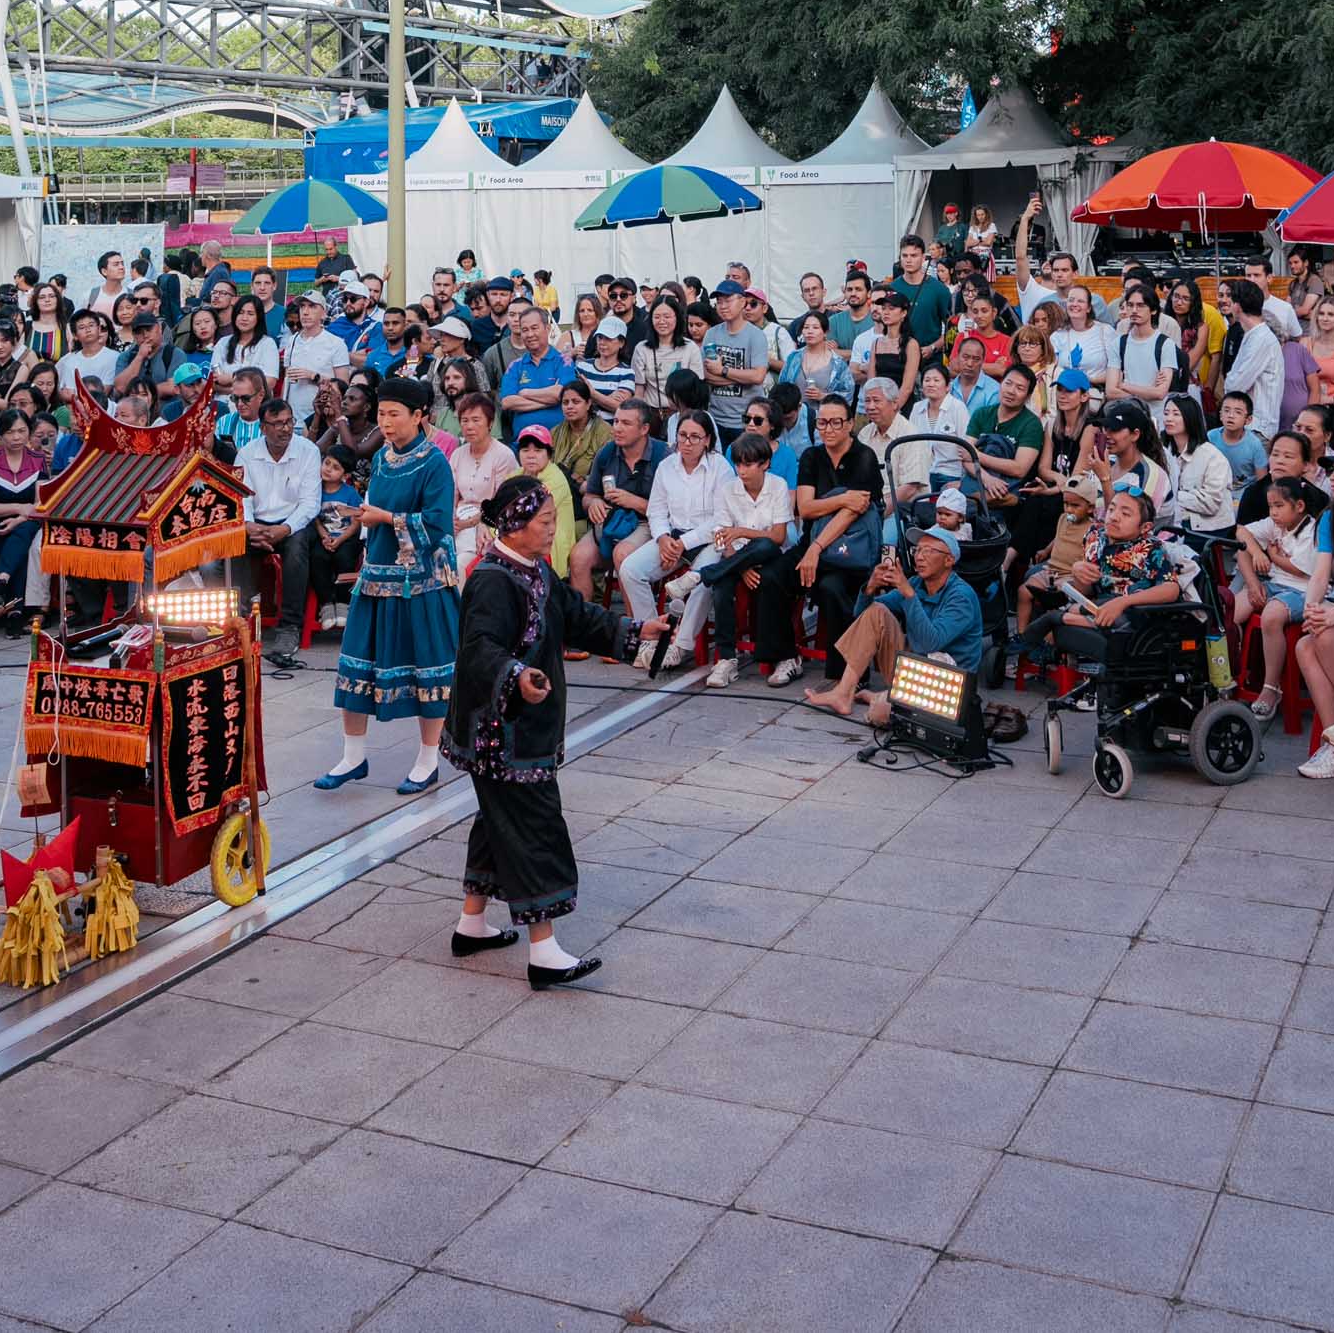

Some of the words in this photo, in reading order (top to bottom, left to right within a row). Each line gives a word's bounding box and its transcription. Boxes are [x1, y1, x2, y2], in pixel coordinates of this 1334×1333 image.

[540, 115, 569, 127] MAISON
[779, 171, 798, 179] Food
[801, 170, 819, 179] Area
[359, 178, 376, 186] Food
[489, 176, 506, 184] Food
[507, 176, 524, 184] Area
